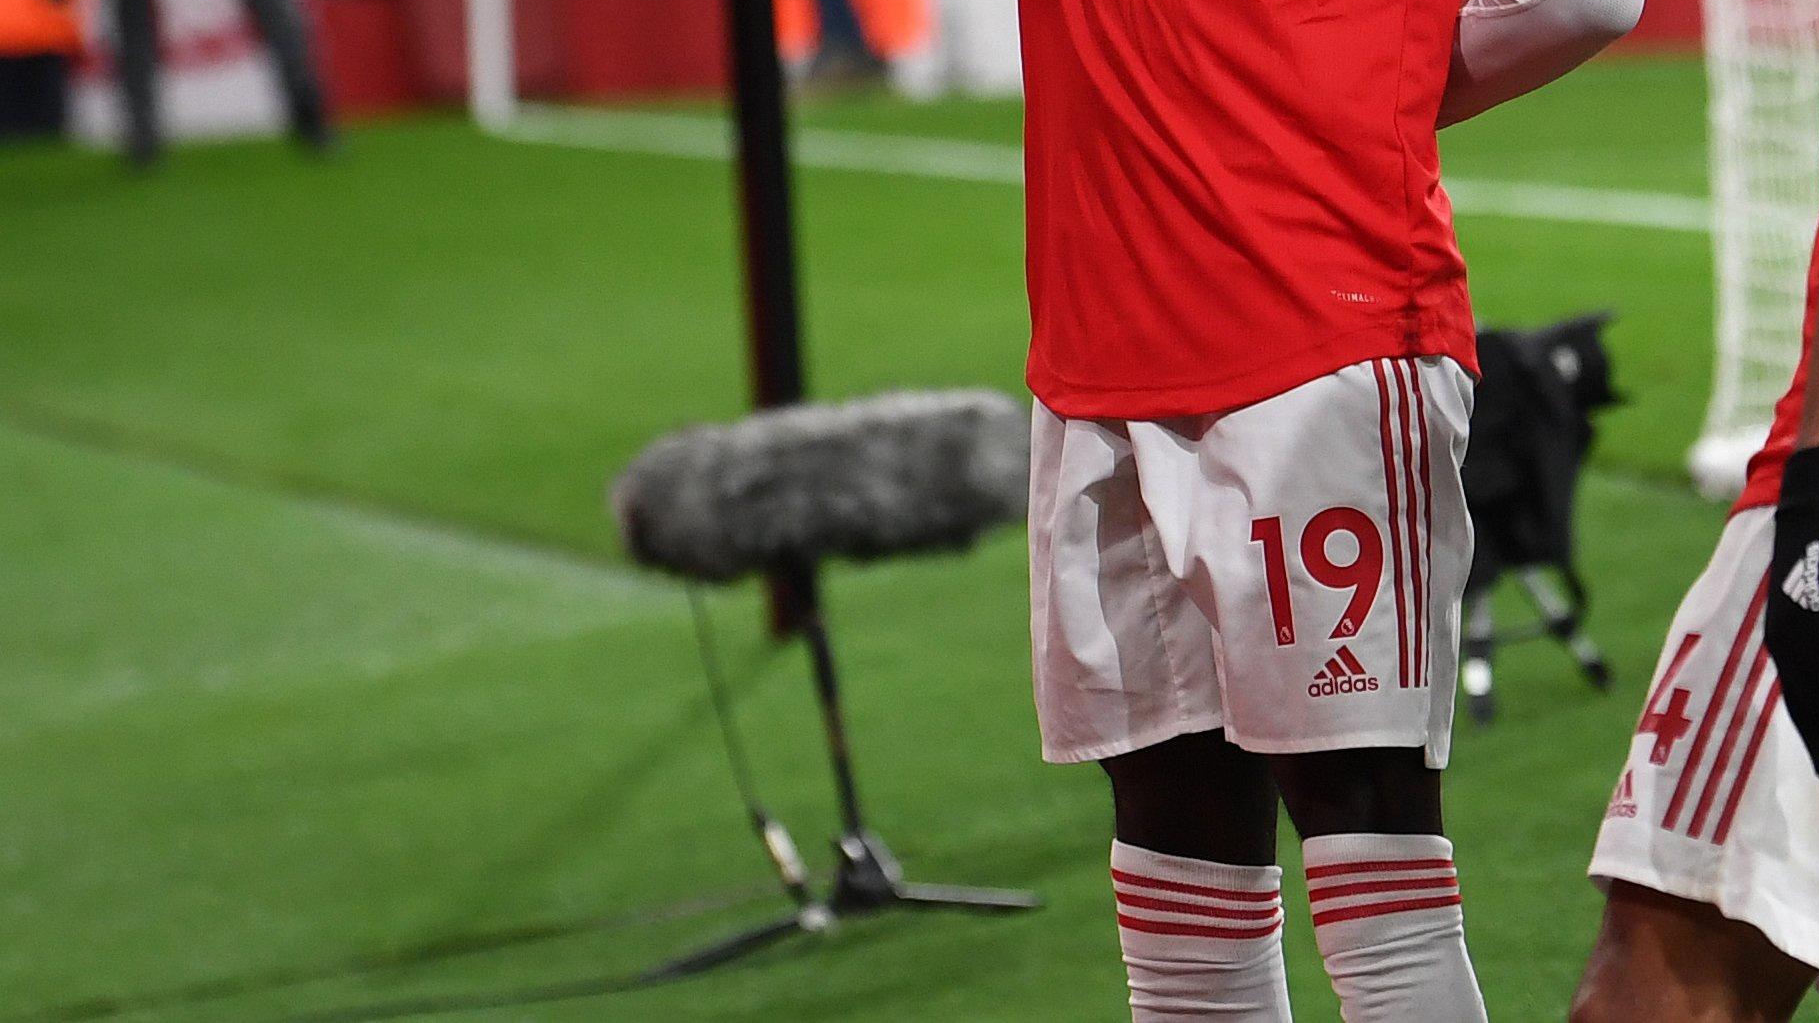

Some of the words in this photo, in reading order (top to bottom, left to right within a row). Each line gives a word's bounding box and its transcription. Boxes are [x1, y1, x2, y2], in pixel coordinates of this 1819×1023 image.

[1250, 506, 1384, 647] 19
[1308, 676, 1379, 698] adidas
[1638, 633, 1702, 766] 4
